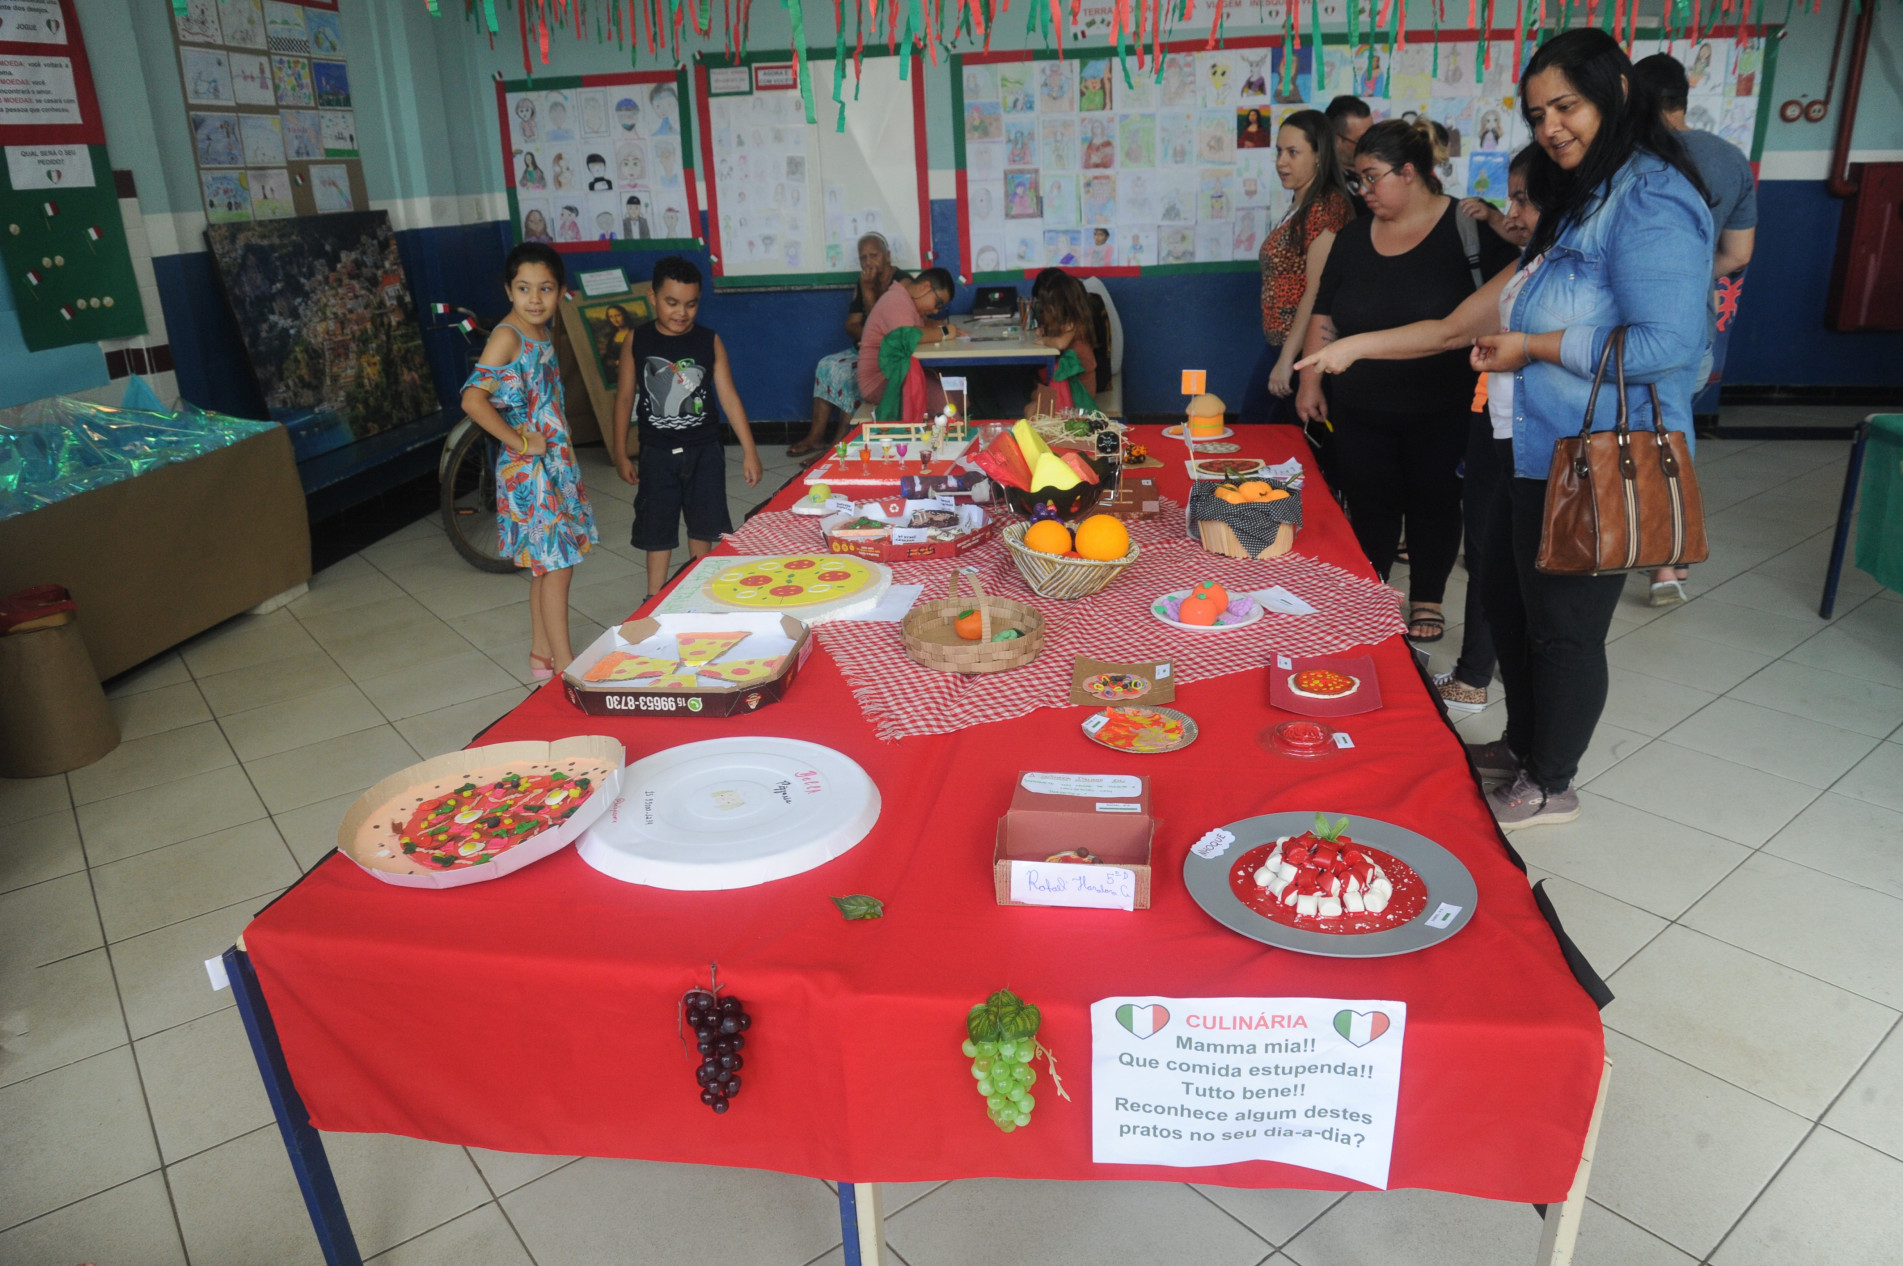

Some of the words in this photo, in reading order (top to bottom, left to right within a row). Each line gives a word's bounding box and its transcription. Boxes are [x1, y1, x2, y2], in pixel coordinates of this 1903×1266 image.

[1084, 7, 1113, 16] TERRA
[16, 23, 37, 31] JOGUE
[605, 695, 676, 711] 99653-8730
[676, 698, 687, 707] 15
[1198, 832, 1226, 857] NHOQUE
[1186, 1012, 1308, 1030] CULINÁRIA
[1176, 1035, 1257, 1055] Mamma
[1264, 1038, 1316, 1053] mia!!
[1118, 1052, 1160, 1069] Que
[1166, 1057, 1242, 1078] comida
[1249, 1061, 1374, 1079] estupenda!!
[1181, 1081, 1236, 1100] Tutto
[1242, 1083, 1306, 1100] bene!!
[1115, 1097, 1228, 1122] Reconhece
[1235, 1106, 1297, 1122] algum
[1304, 1105, 1373, 1125] destes
[1119, 1122, 1183, 1140] pratos
[1190, 1131, 1215, 1142] no
[1221, 1129, 1257, 1141] seu
[1264, 1126, 1365, 1148] dia-a-dia?
